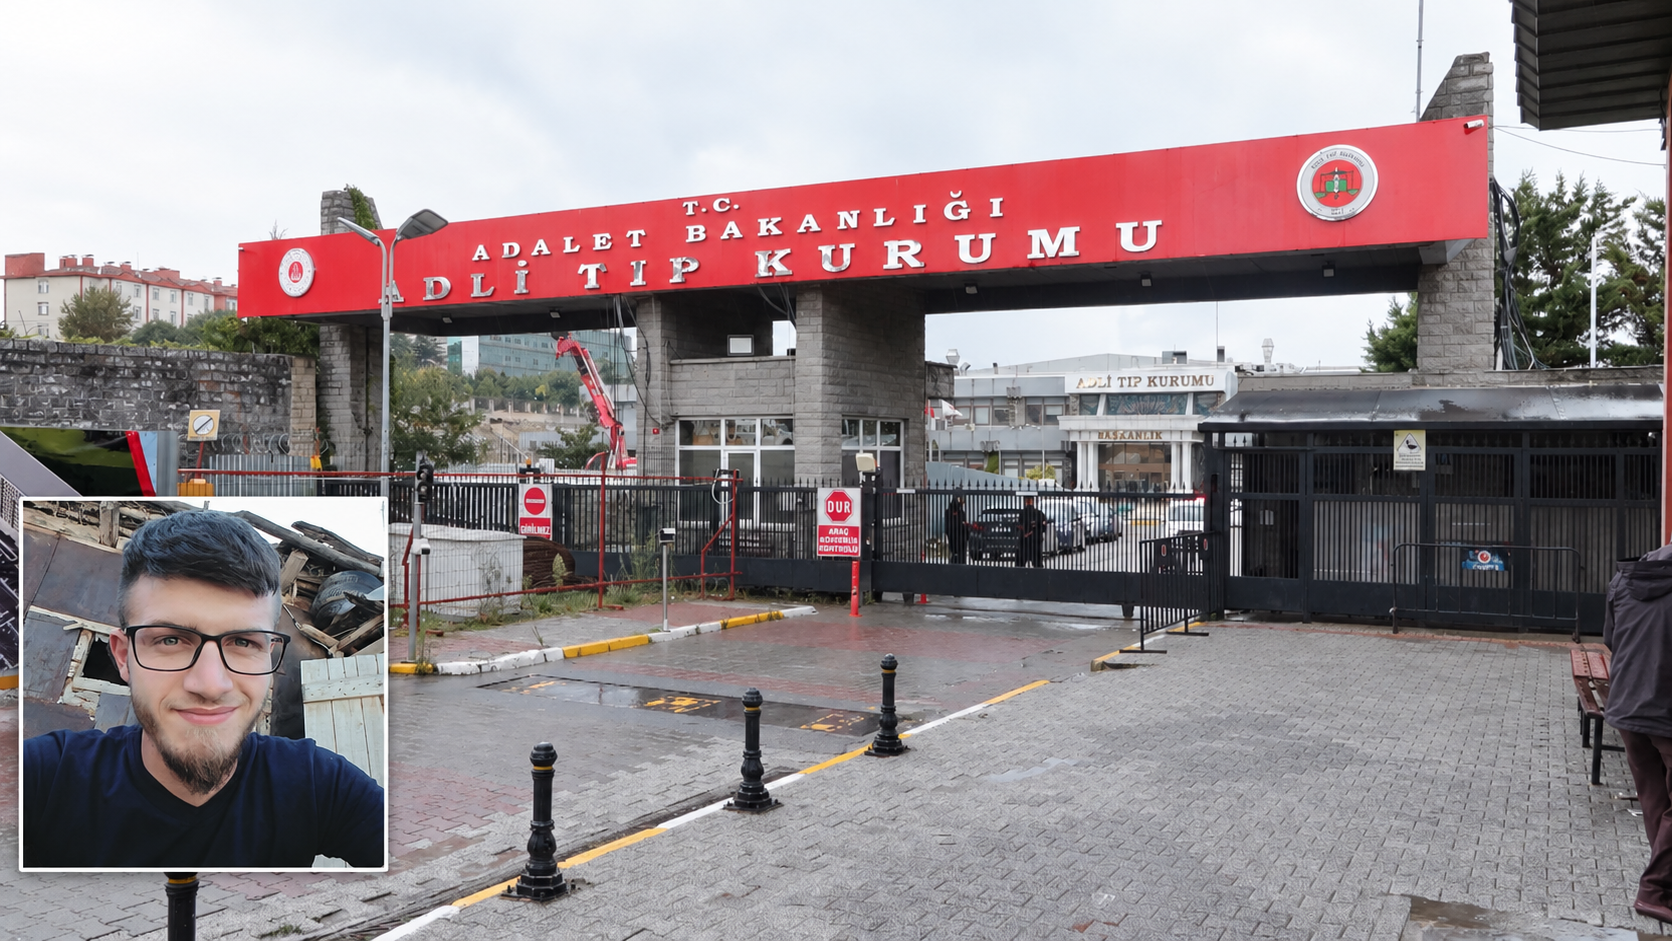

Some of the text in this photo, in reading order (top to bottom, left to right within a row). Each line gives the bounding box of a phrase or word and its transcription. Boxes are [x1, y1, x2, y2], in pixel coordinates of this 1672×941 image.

[682, 197, 741, 216] T.C.
[472, 190, 1004, 262] ADALET BAKANLIĞI
[378, 219, 1163, 304] ADLİ TIP KURUMU
[1076, 375, 1215, 389] ADLİ TIP KURUMU
[827, 500, 851, 513] DUR
